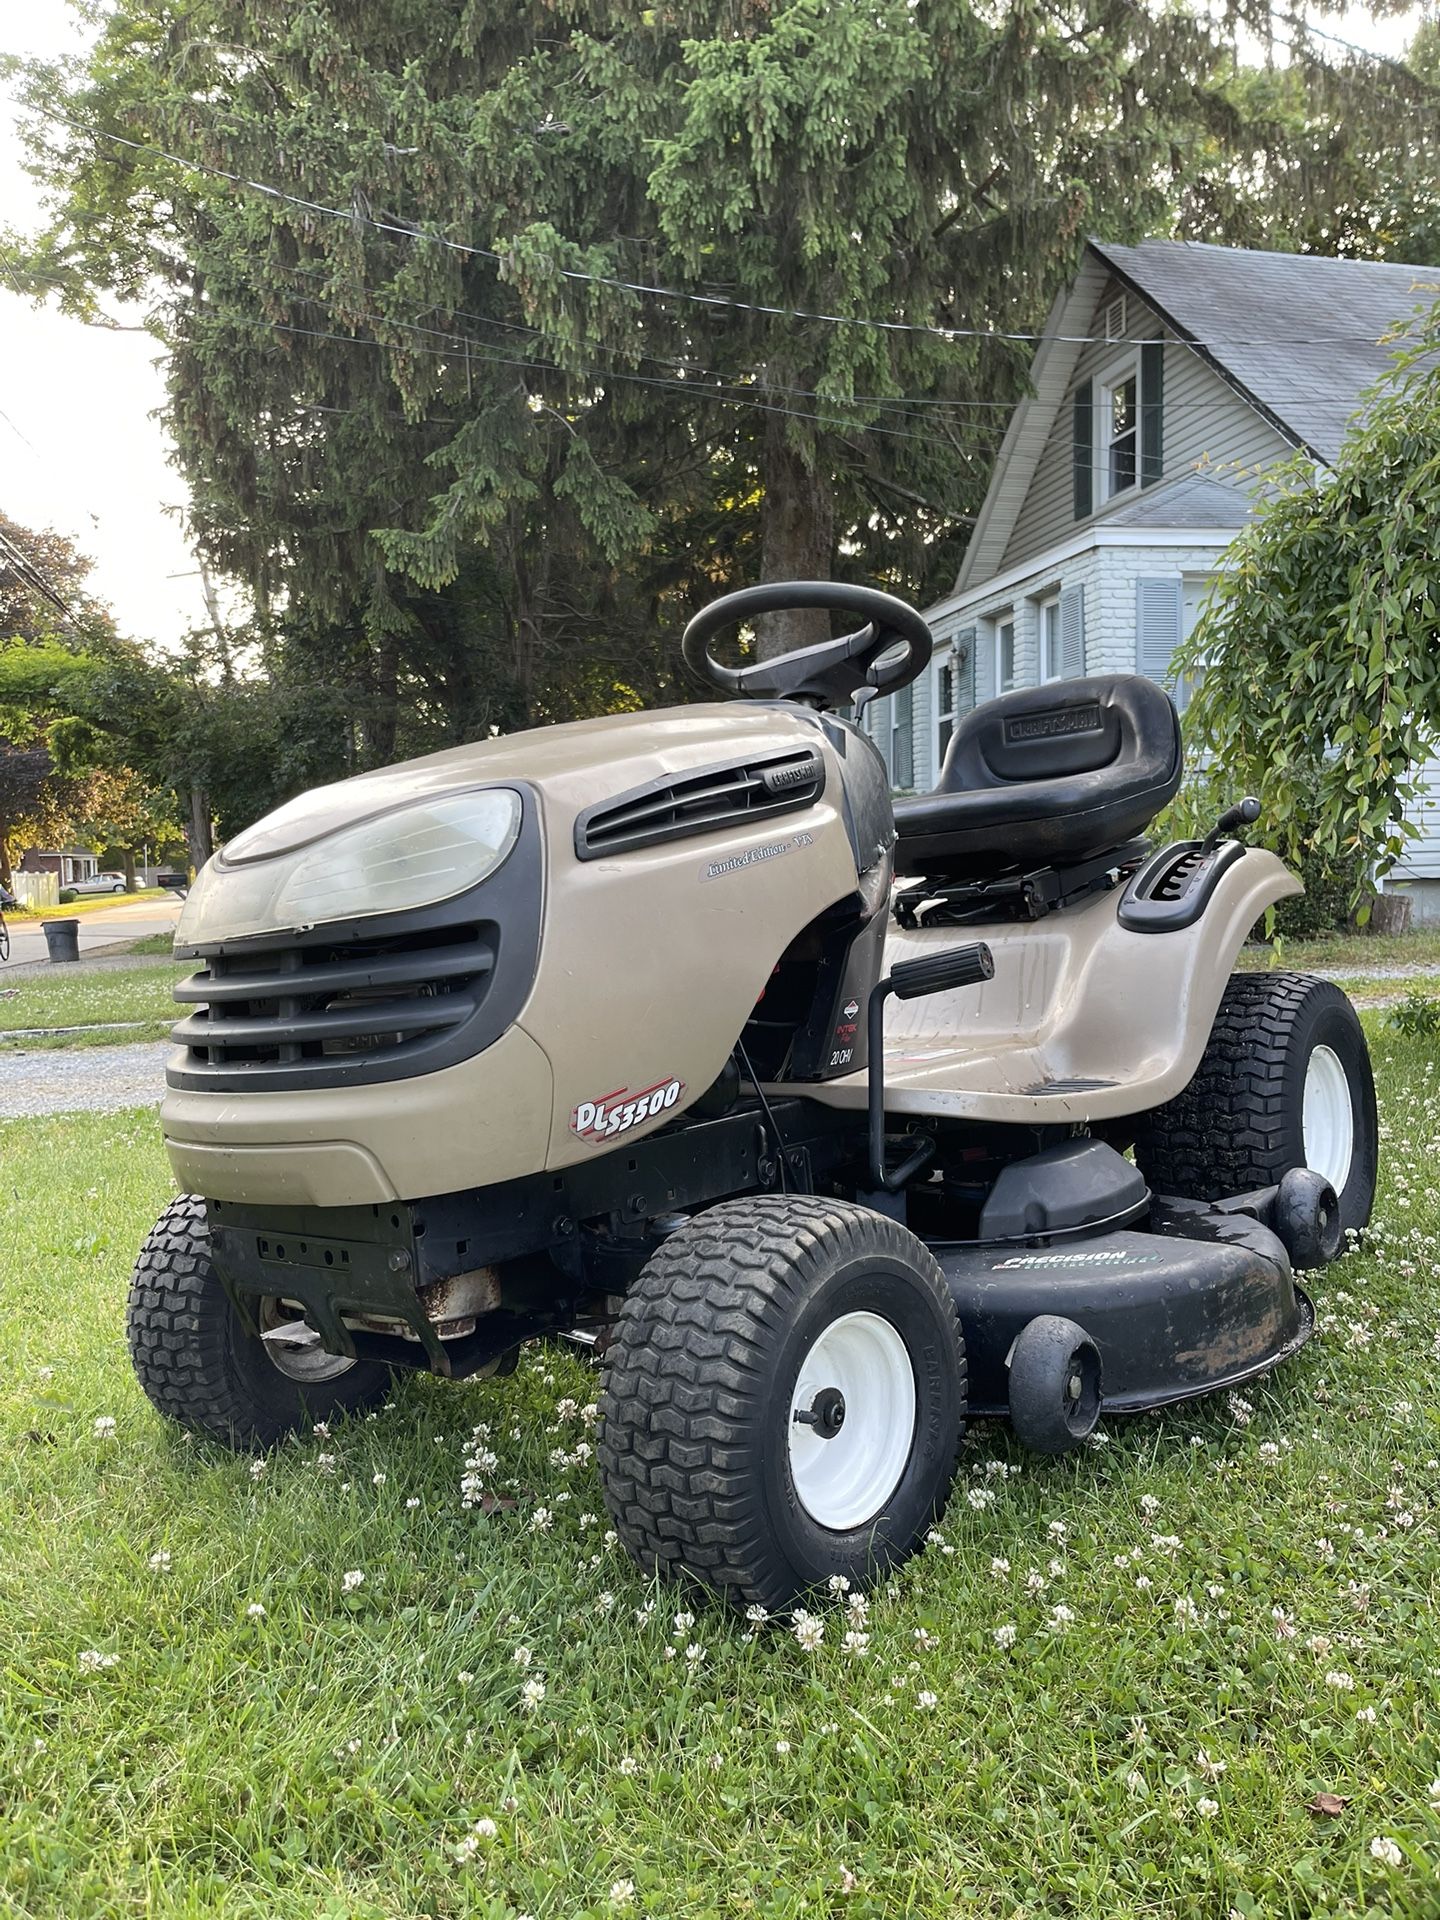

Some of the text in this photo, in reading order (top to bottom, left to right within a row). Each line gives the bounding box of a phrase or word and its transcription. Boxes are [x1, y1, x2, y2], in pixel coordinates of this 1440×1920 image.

[772, 764, 816, 786] CRAFTSMAN
[707, 851, 750, 877] Limited
[748, 843, 786, 862] Edition
[830, 1048, 854, 1066] 20 OHV
[576, 1081, 680, 1136] DLS3500
[1004, 1251, 1127, 1265] PRECISION
